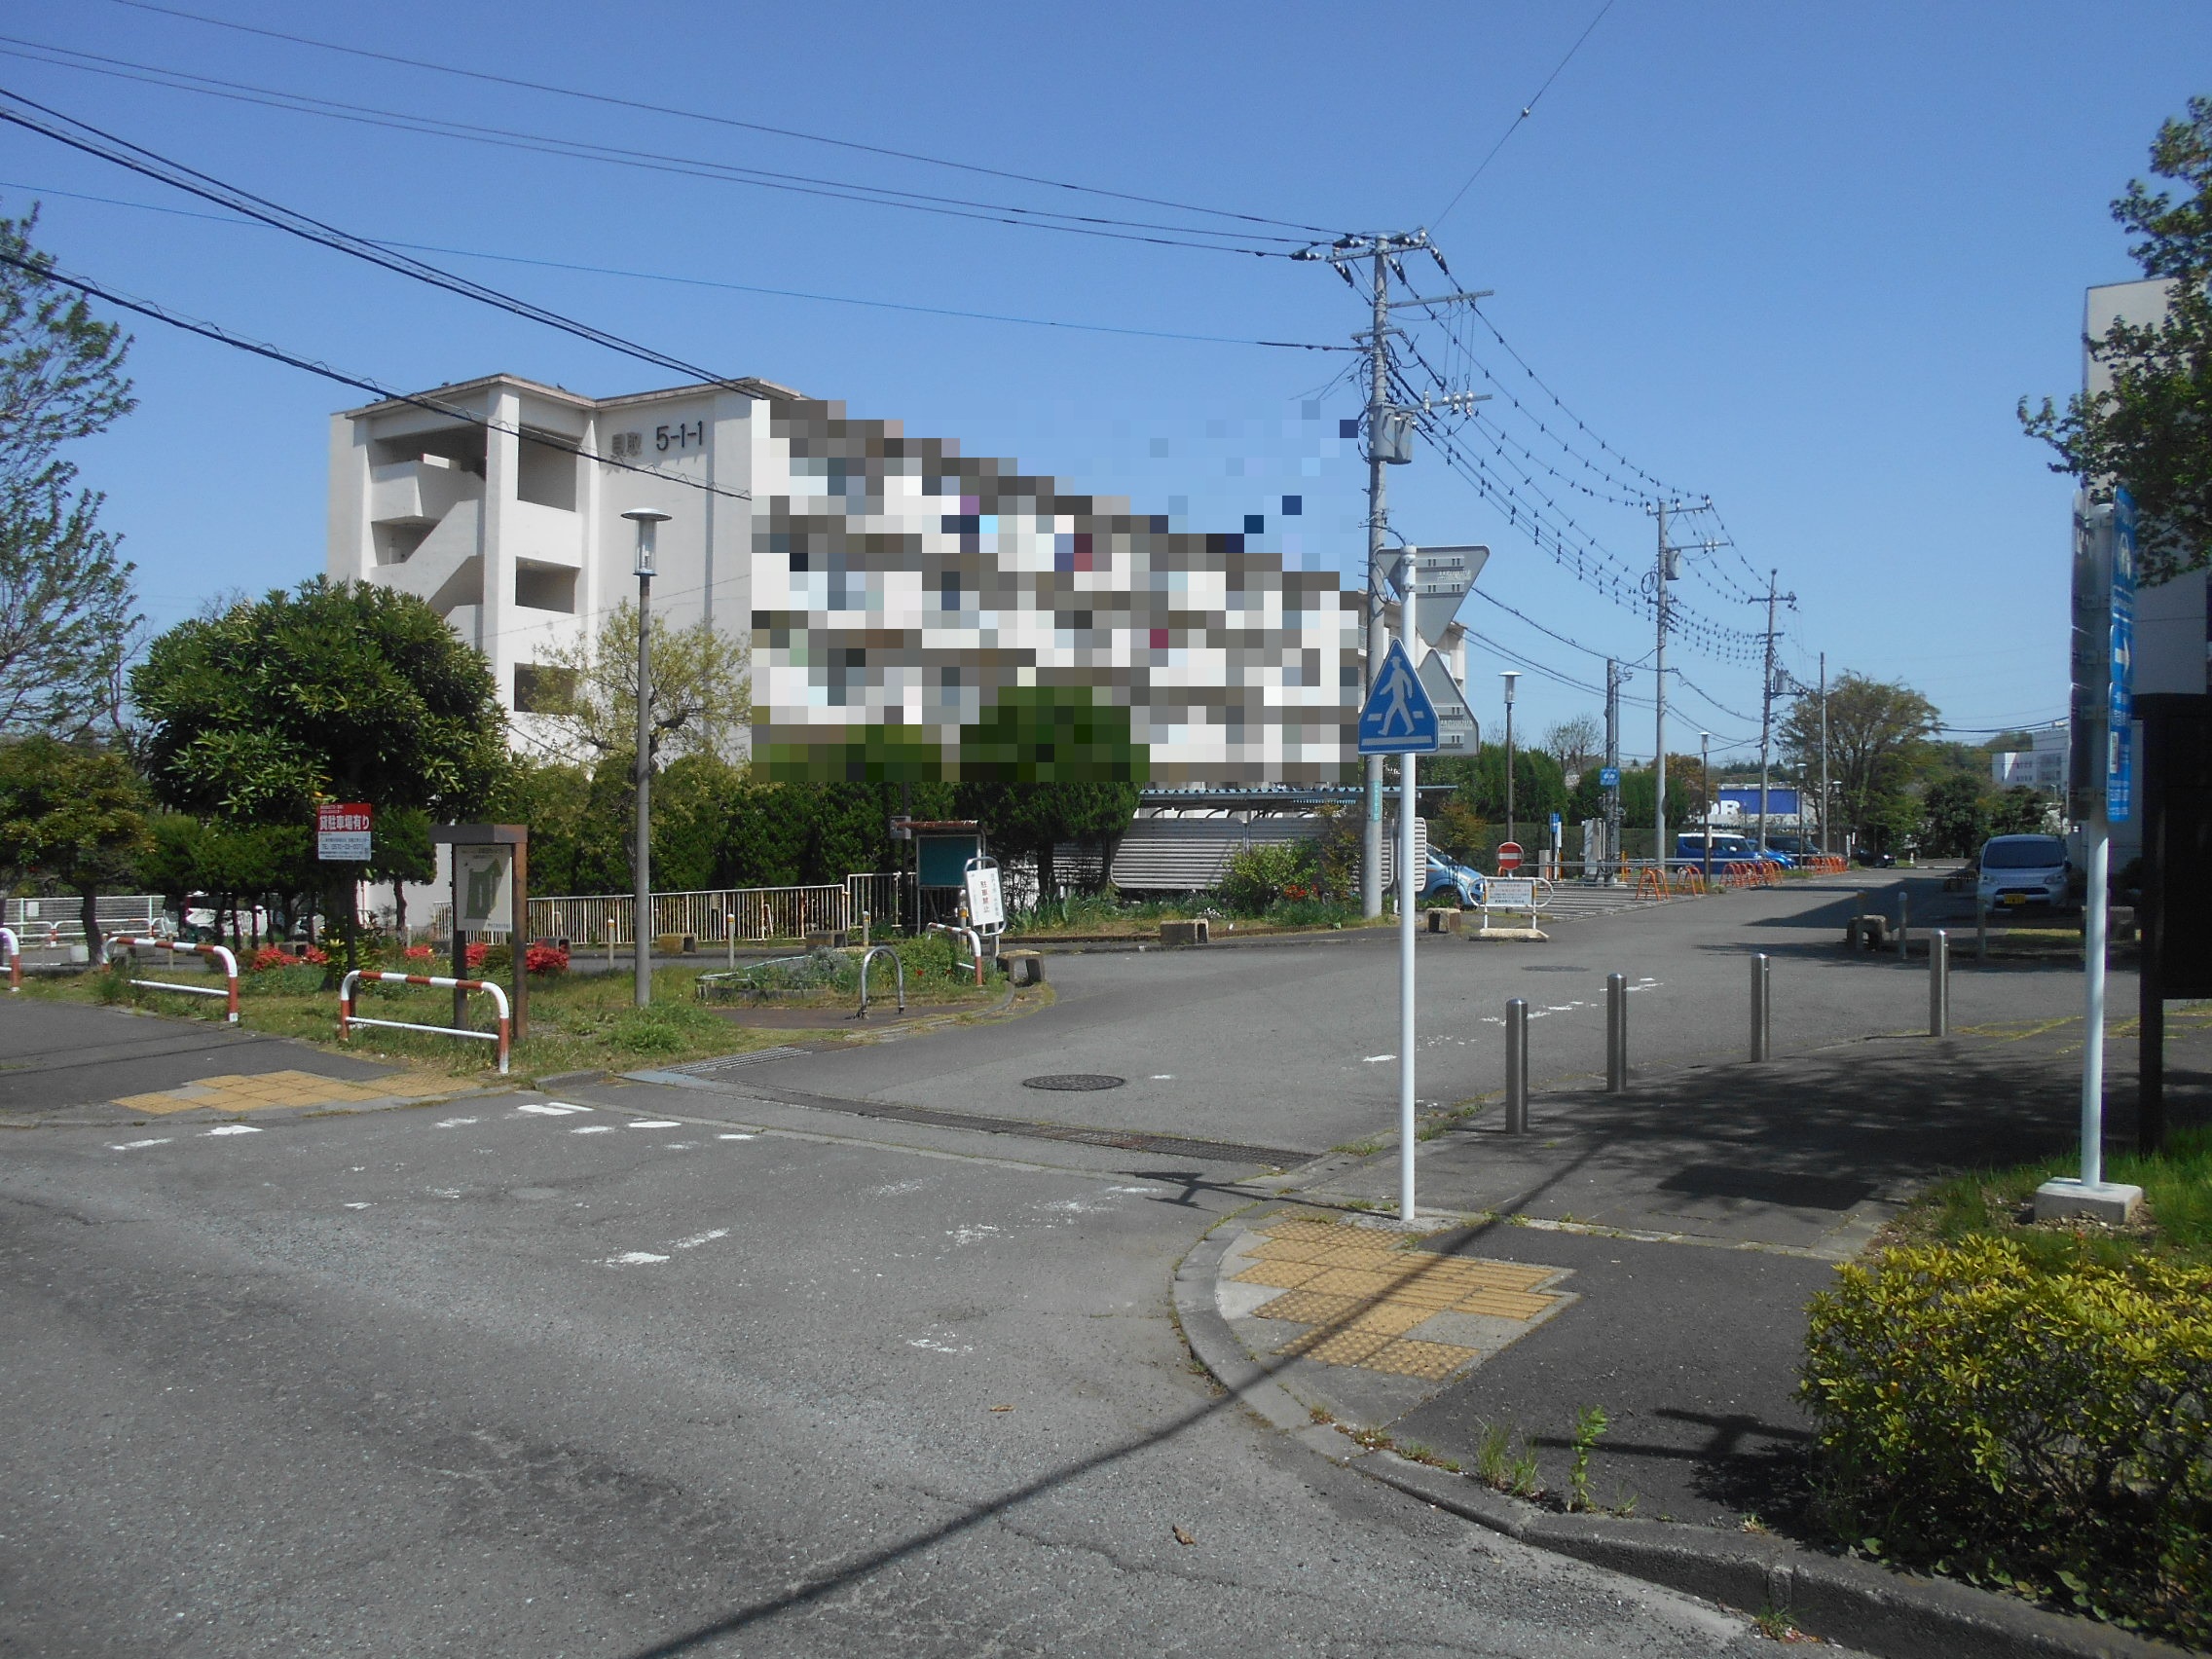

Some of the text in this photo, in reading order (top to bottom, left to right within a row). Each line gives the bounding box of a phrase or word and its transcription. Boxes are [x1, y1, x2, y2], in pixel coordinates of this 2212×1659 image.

[656, 420, 703, 452] 5-1-1
[319, 815, 370, 830] 貸駐車場有り
